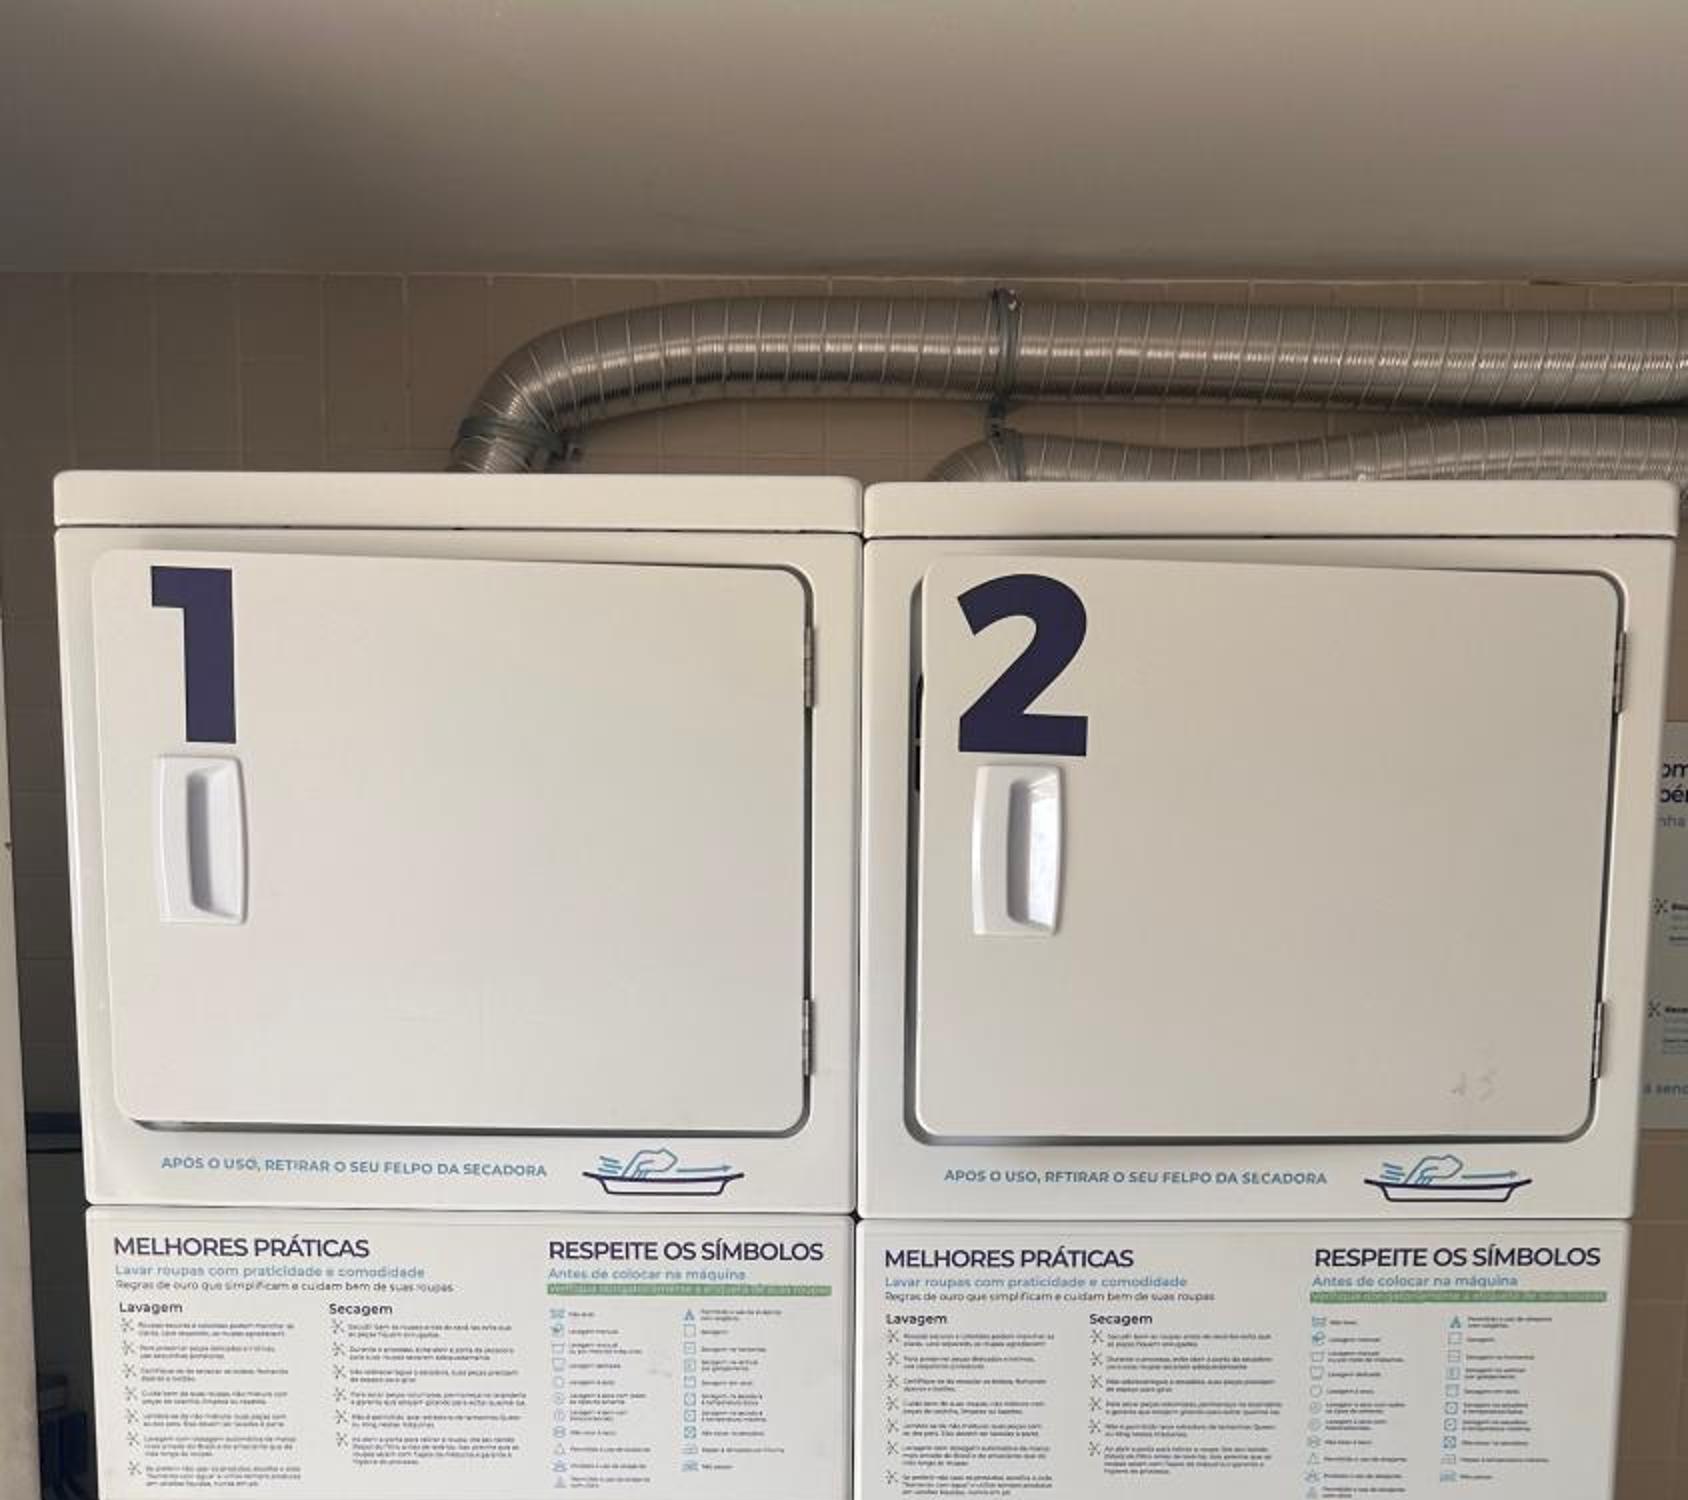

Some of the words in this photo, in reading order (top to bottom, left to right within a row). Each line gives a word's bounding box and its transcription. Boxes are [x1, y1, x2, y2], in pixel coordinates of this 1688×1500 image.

[150, 565, 237, 744] 1
[956, 573, 1089, 757] 2
[208, 1157, 220, 1169] O
[224, 1158, 261, 1172] USO,
[265, 1159, 330, 1172] RETIRAR
[335, 1160, 346, 1173] O
[350, 1160, 379, 1174] SEU
[384, 1161, 433, 1175] FELPO
[437, 1163, 460, 1176] DA
[464, 1163, 547, 1177] SECADORA
[989, 1170, 1001, 1182] O
[1005, 1170, 1041, 1184] USO,
[1113, 1171, 1125, 1184] O
[1129, 1171, 1158, 1184] SEU
[1163, 1172, 1212, 1185] FELPO
[1216, 1172, 1239, 1185] DA
[1242, 1172, 1328, 1186] SECADORA
[113, 1236, 249, 1257] MELHORES
[254, 1233, 370, 1258] PRÁTICAS
[549, 1241, 659, 1260] RESPEITE
[663, 1241, 697, 1260] OS
[701, 1237, 824, 1261] SÍMBOLOS
[885, 1249, 1015, 1268] MELHORES
[1020, 1245, 1134, 1268] PRÁTICAS
[1314, 1247, 1428, 1267] RESPEITE
[1433, 1247, 1467, 1267] OS
[1472, 1243, 1601, 1266] SÍMBOLOS
[115, 1264, 156, 1276] Lavar
[157, 1265, 205, 1278] roupas
[208, 1267, 239, 1276] com
[243, 1265, 322, 1279] praticidade
[326, 1268, 335, 1277] e
[338, 1266, 425, 1278] comodidade
[549, 1268, 588, 1279] Antes
[591, 1268, 609, 1279] de
[612, 1268, 660, 1279] colocar
[665, 1270, 683, 1279] na
[686, 1268, 746, 1281] máquina
[116, 1279, 154, 1291] Regras
[156, 1280, 171, 1289] de
[173, 1281, 199, 1290] ouro
[202, 1282, 223, 1292] que
[225, 1280, 289, 1292] simplificam
[302, 1281, 342, 1291] cuidam
[345, 1281, 370, 1291] bem
[373, 1282, 387, 1291] de
[391, 1283, 413, 1291] suas
[416, 1283, 454, 1293] roupas
[885, 1277, 922, 1287] Lavar
[925, 1278, 972, 1290] roupas
[974, 1279, 1005, 1287] com
[1008, 1276, 1086, 1289] praticidade
[1089, 1279, 1098, 1287] e
[1101, 1276, 1187, 1287] comodidade
[1312, 1275, 1353, 1287] Antes
[1357, 1275, 1375, 1287] de
[1377, 1274, 1430, 1287] colocar
[1433, 1277, 1451, 1287] na
[1455, 1274, 1518, 1288] máquina
[885, 1291, 923, 1303] Regras
[924, 1291, 937, 1301] de
[939, 1292, 964, 1301] ouro
[966, 1293, 988, 1303] que
[990, 1290, 1052, 1303] simplificam
[1054, 1292, 1061, 1300] e
[1064, 1290, 1105, 1301] cuidam
[1107, 1291, 1133, 1301] bem
[1135, 1291, 1148, 1301] de
[1151, 1292, 1174, 1301] suas
[1177, 1293, 1215, 1304] roupas
[119, 1301, 183, 1315] Lavagem
[329, 1302, 393, 1316] Secagem
[886, 1313, 948, 1327] Lavagem
[1089, 1312, 1153, 1326] Secagem
